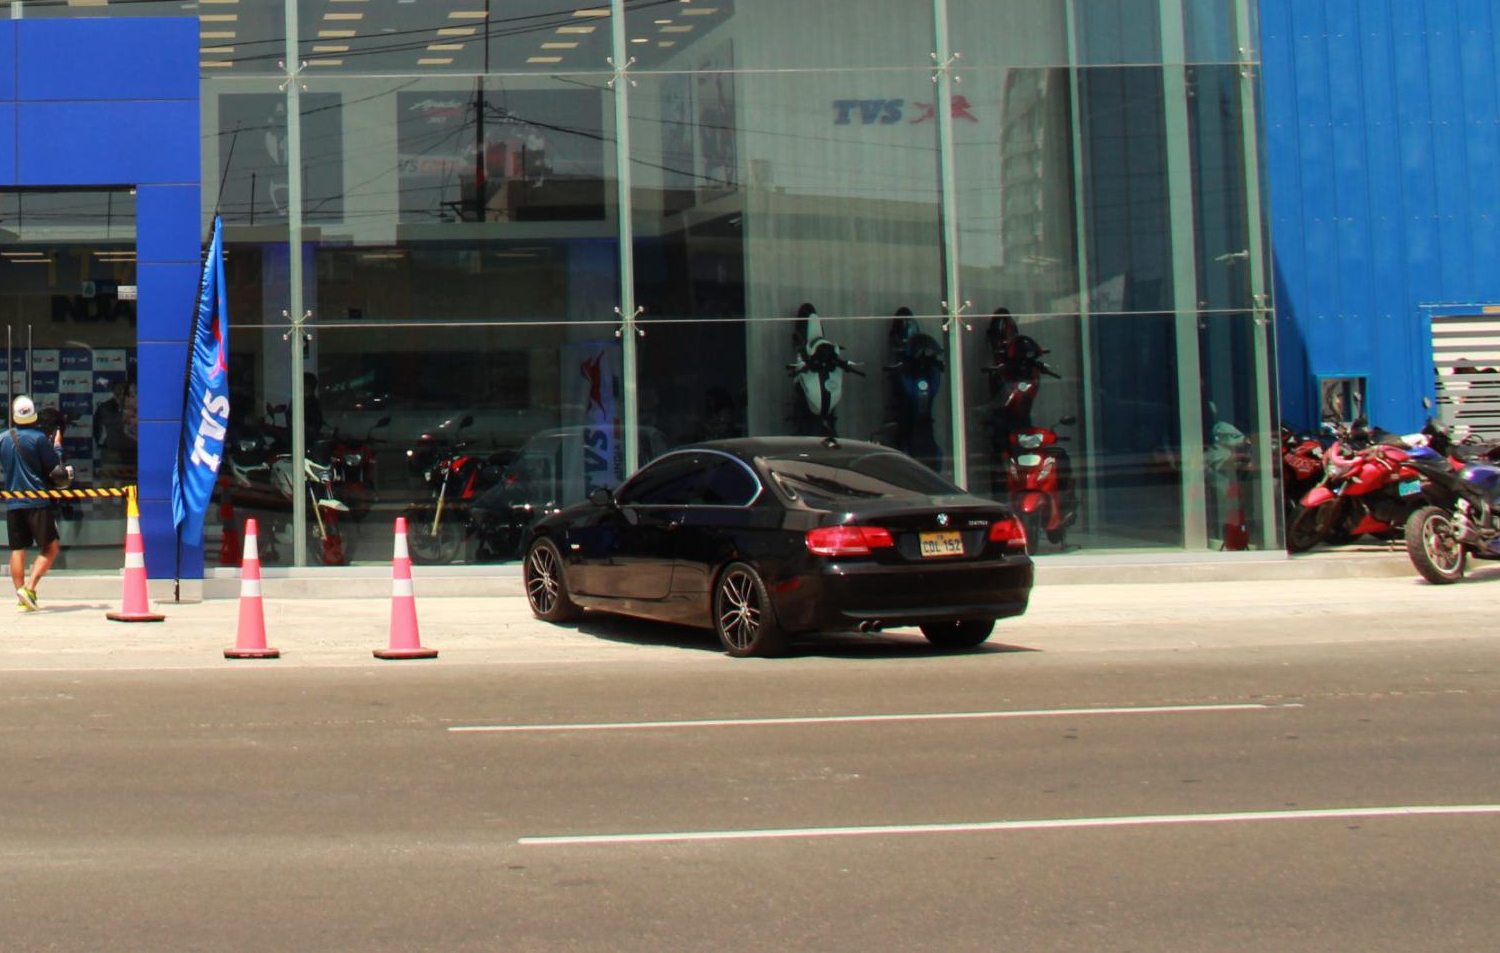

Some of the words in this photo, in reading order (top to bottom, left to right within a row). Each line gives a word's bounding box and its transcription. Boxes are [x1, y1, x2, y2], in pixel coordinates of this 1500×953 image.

[833, 99, 904, 125] TVS
[51, 295, 137, 324] INDIA
[190, 388, 230, 473] TVS
[583, 427, 608, 500] TVS
[943, 538, 961, 552] 152
